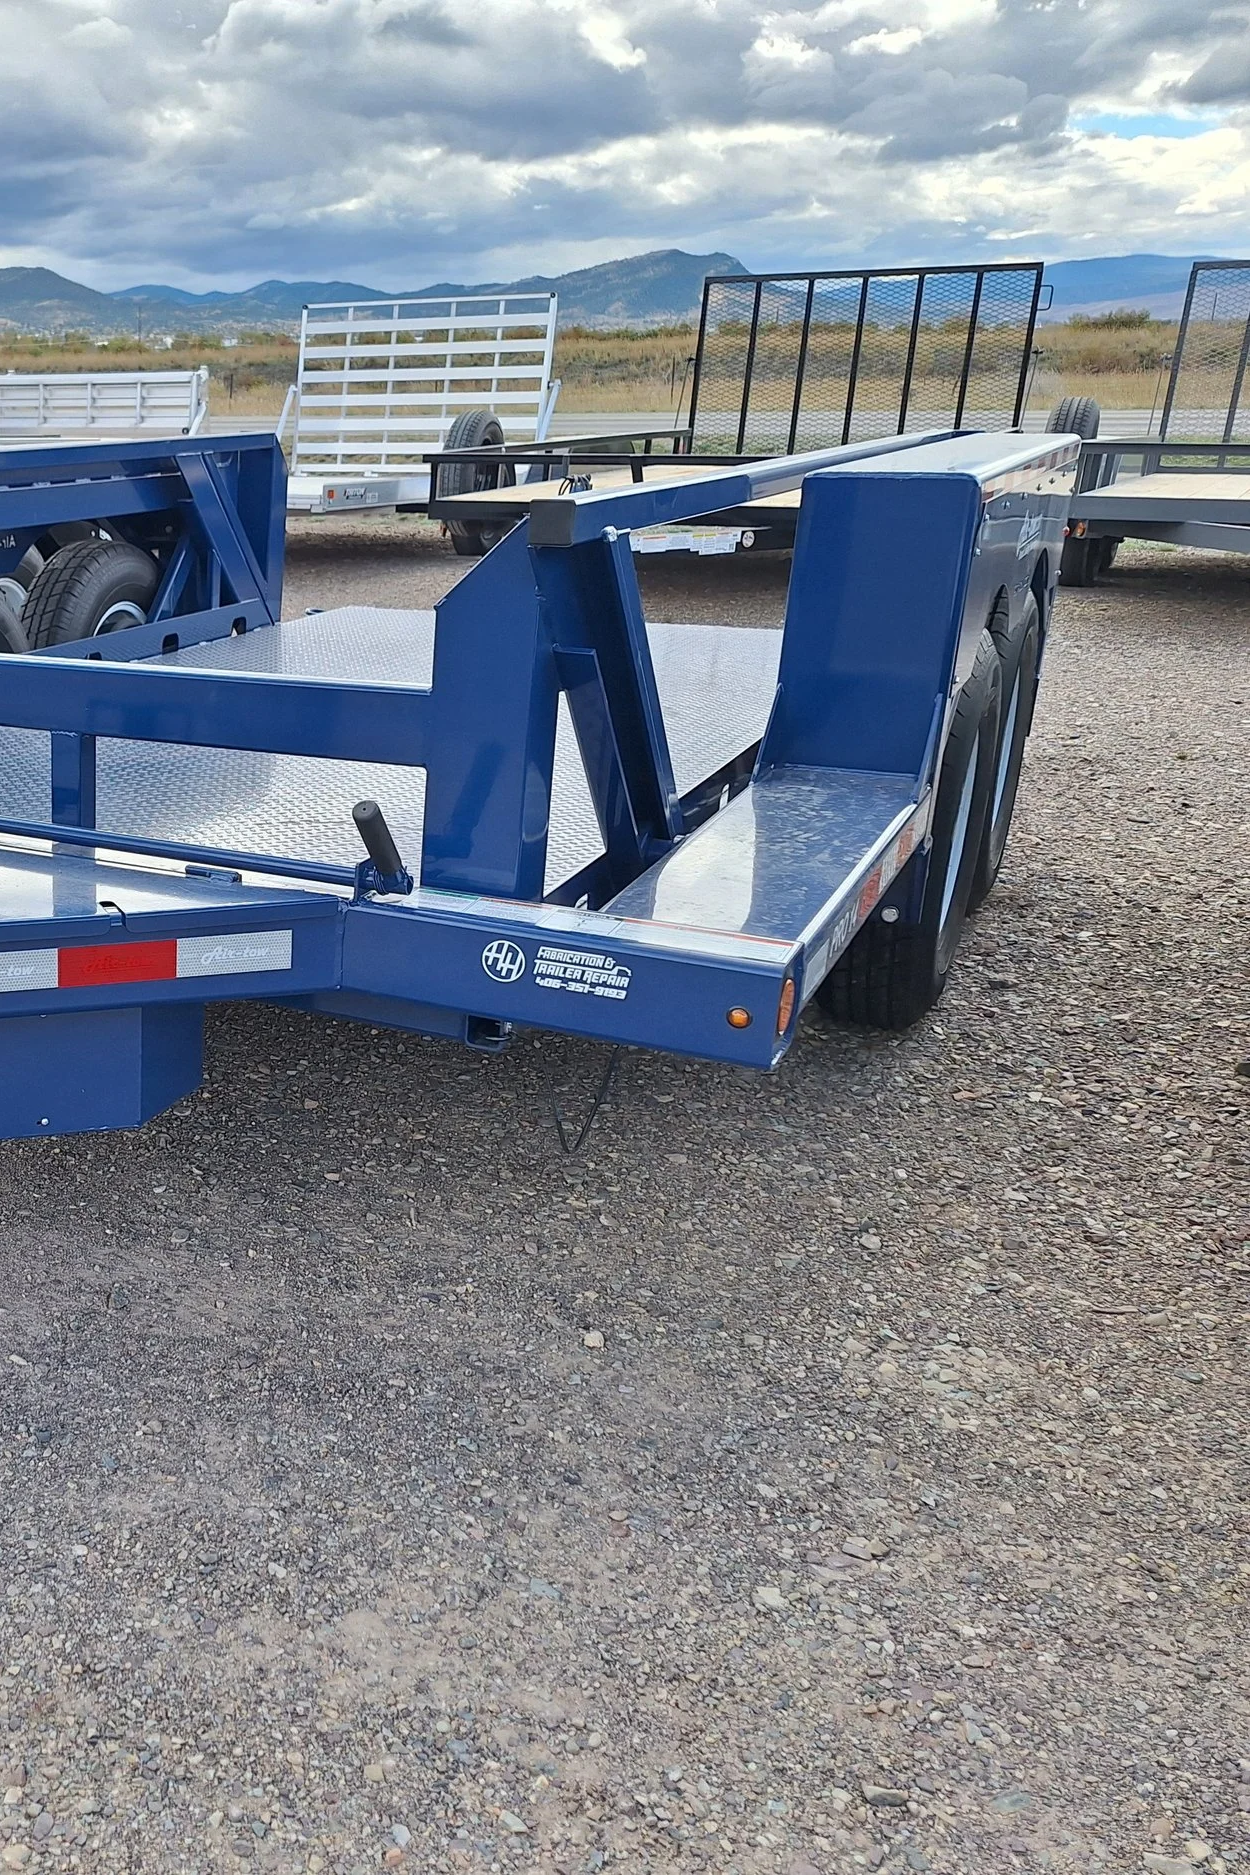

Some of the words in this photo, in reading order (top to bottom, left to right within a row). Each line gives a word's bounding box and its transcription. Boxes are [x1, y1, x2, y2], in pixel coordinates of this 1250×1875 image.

[201, 944, 269, 965] Air-tow
[482, 940, 525, 982] HH
[537, 946, 606, 967] FABRICATION
[533, 959, 583, 980] TRAILER
[583, 969, 630, 988] REPAIR
[535, 976, 627, 1000] 406-351-9193
